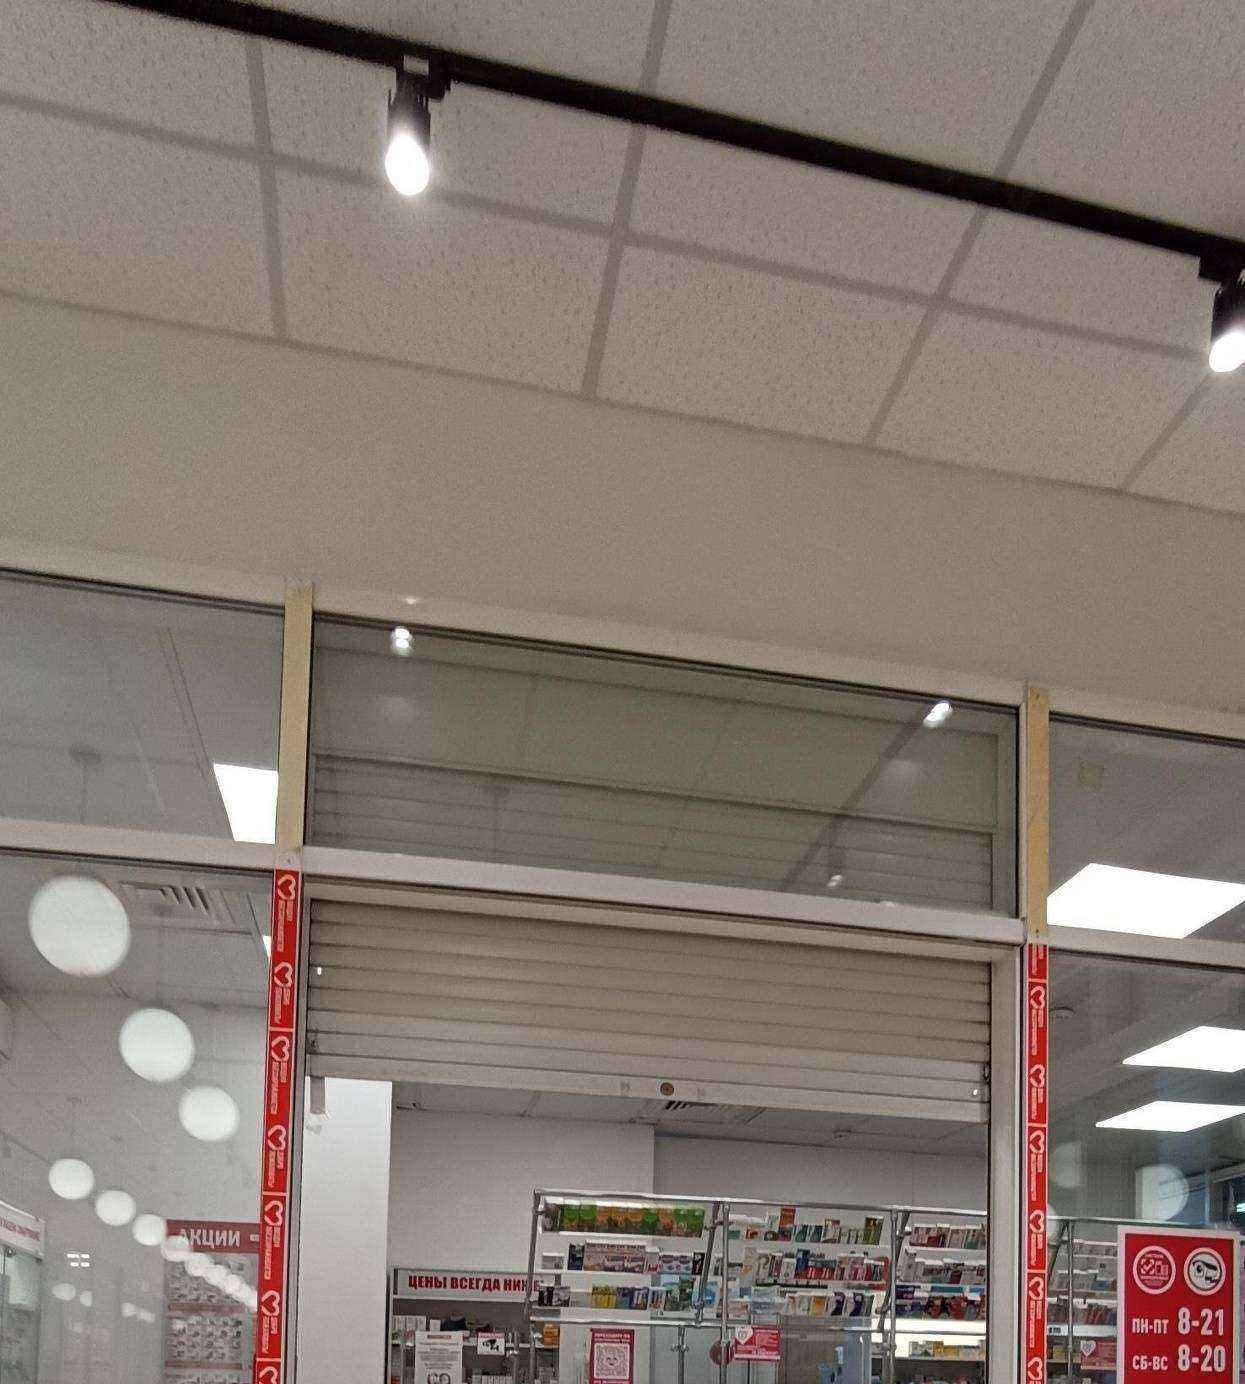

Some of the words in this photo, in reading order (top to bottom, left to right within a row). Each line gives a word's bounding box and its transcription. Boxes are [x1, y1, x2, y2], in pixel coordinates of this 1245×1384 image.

[408, 1274, 447, 1290] ЦЕНЫ
[450, 1276, 501, 1292] ВСЕГДА
[1132, 1318, 1169, 1335] ПН-ПТ
[1178, 1306, 1224, 1336] 8-21
[1132, 1355, 1168, 1371] СБ-ВС
[1178, 1343, 1226, 1373] 8-20
